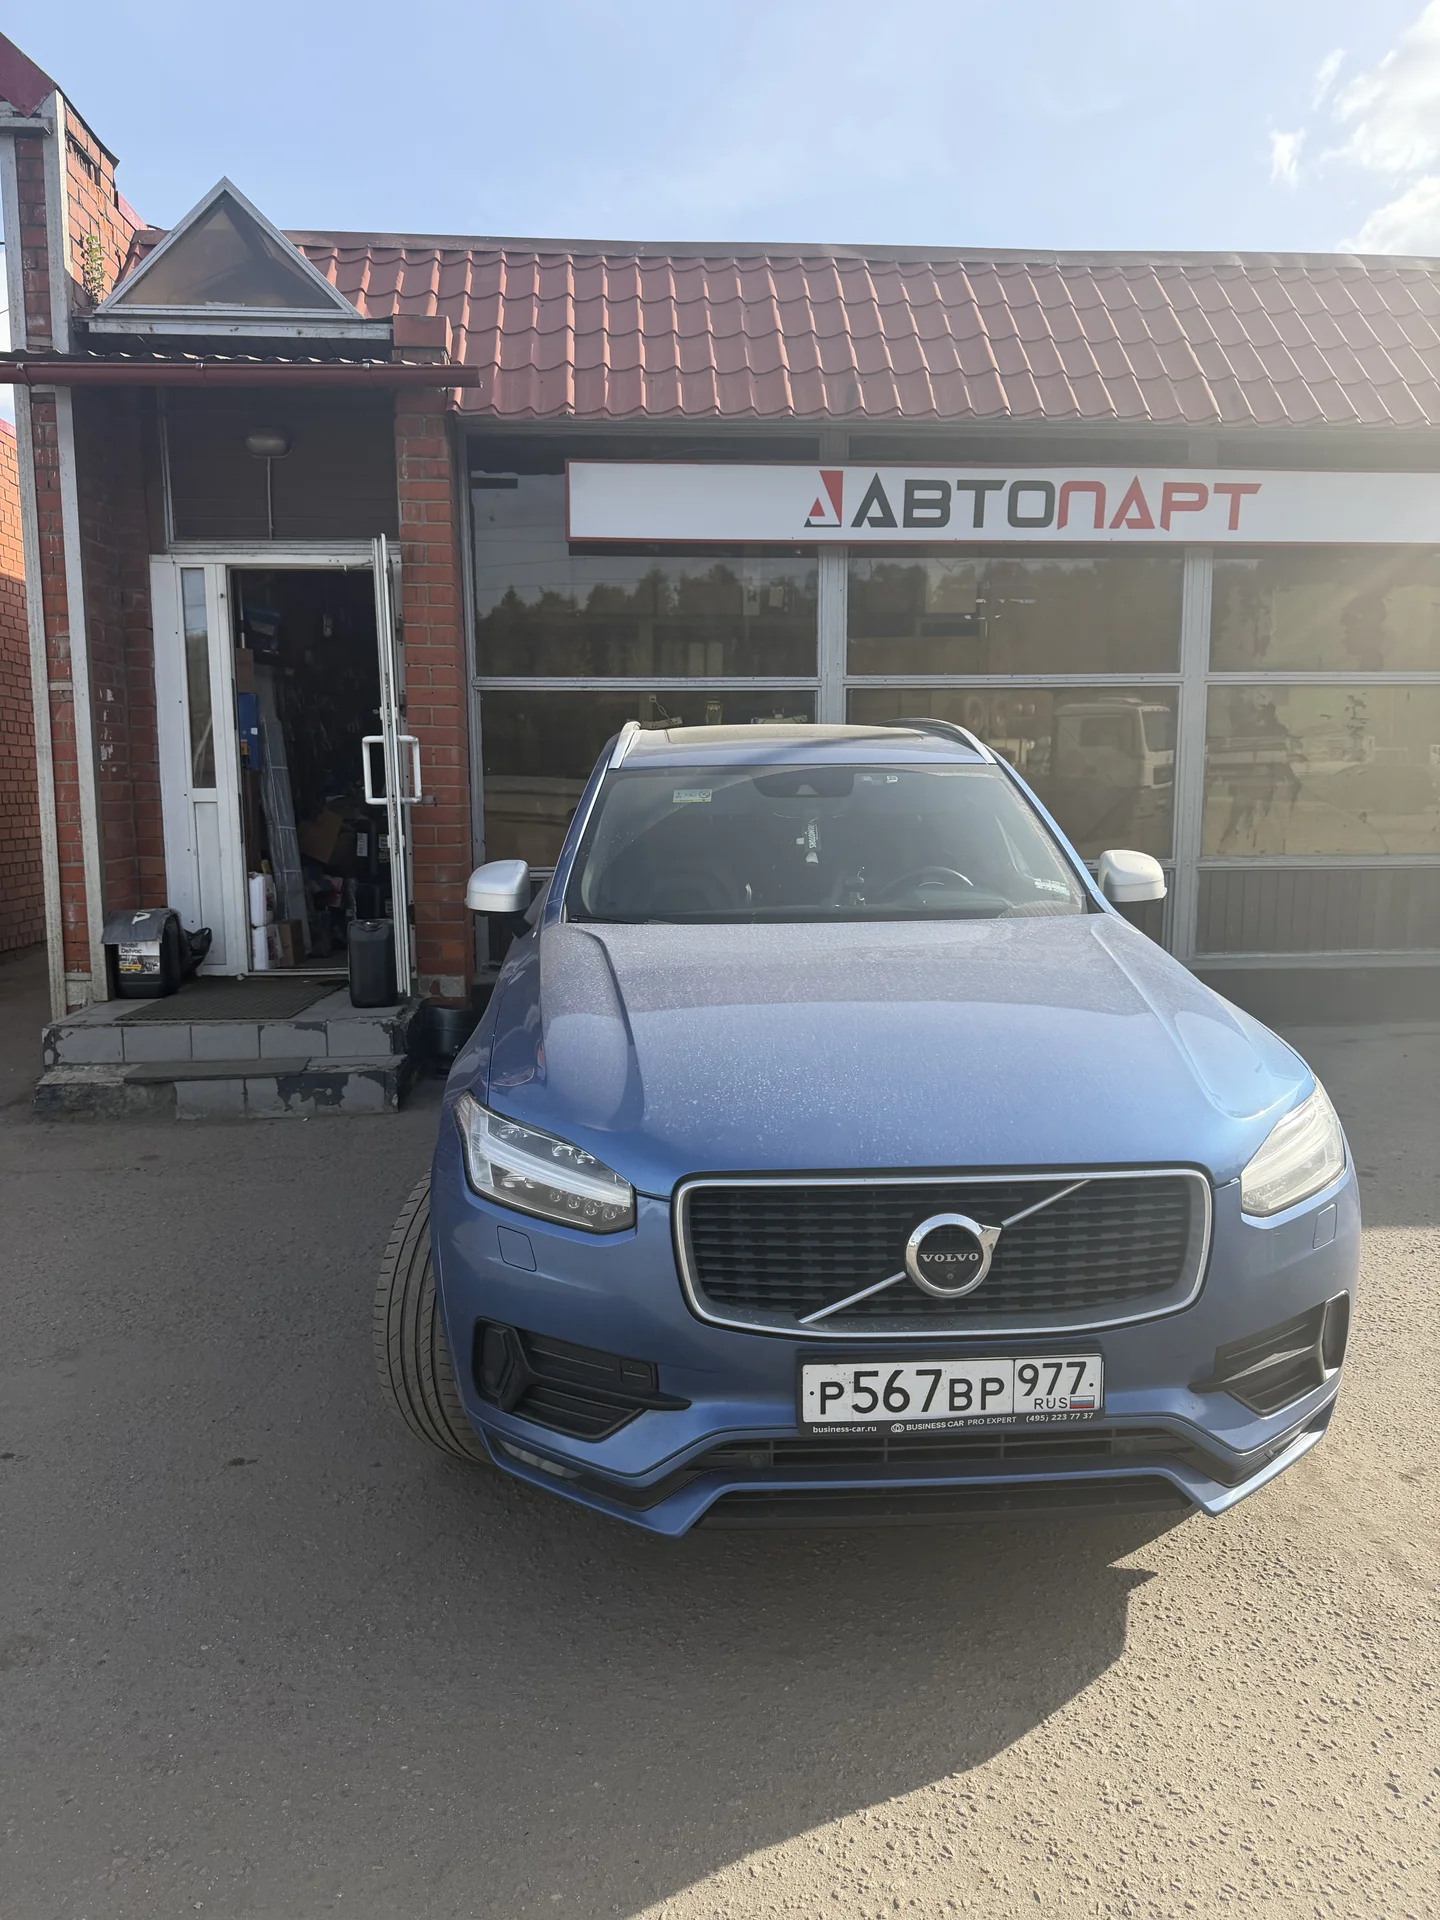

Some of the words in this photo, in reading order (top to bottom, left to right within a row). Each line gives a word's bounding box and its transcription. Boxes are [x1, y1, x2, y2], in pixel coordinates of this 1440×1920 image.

[850, 472, 1262, 532] АВТОПАРТ
[920, 1253, 979, 1262] VOLVO
[1018, 1361, 1087, 1396] 977
[1034, 1397, 1068, 1410] RUS
[906, 1422, 947, 1431] BUSINESS
[947, 1420, 965, 1428] CAR
[967, 1418, 985, 1426] PRO
[986, 1416, 1018, 1425] EXPERT
[1026, 1414, 1049, 1422] (495)
[1051, 1413, 1068, 1421] 223
[1070, 1412, 1082, 1420] 77
[1082, 1412, 1095, 1420] 37
[812, 1425, 878, 1433] business-car.ru
